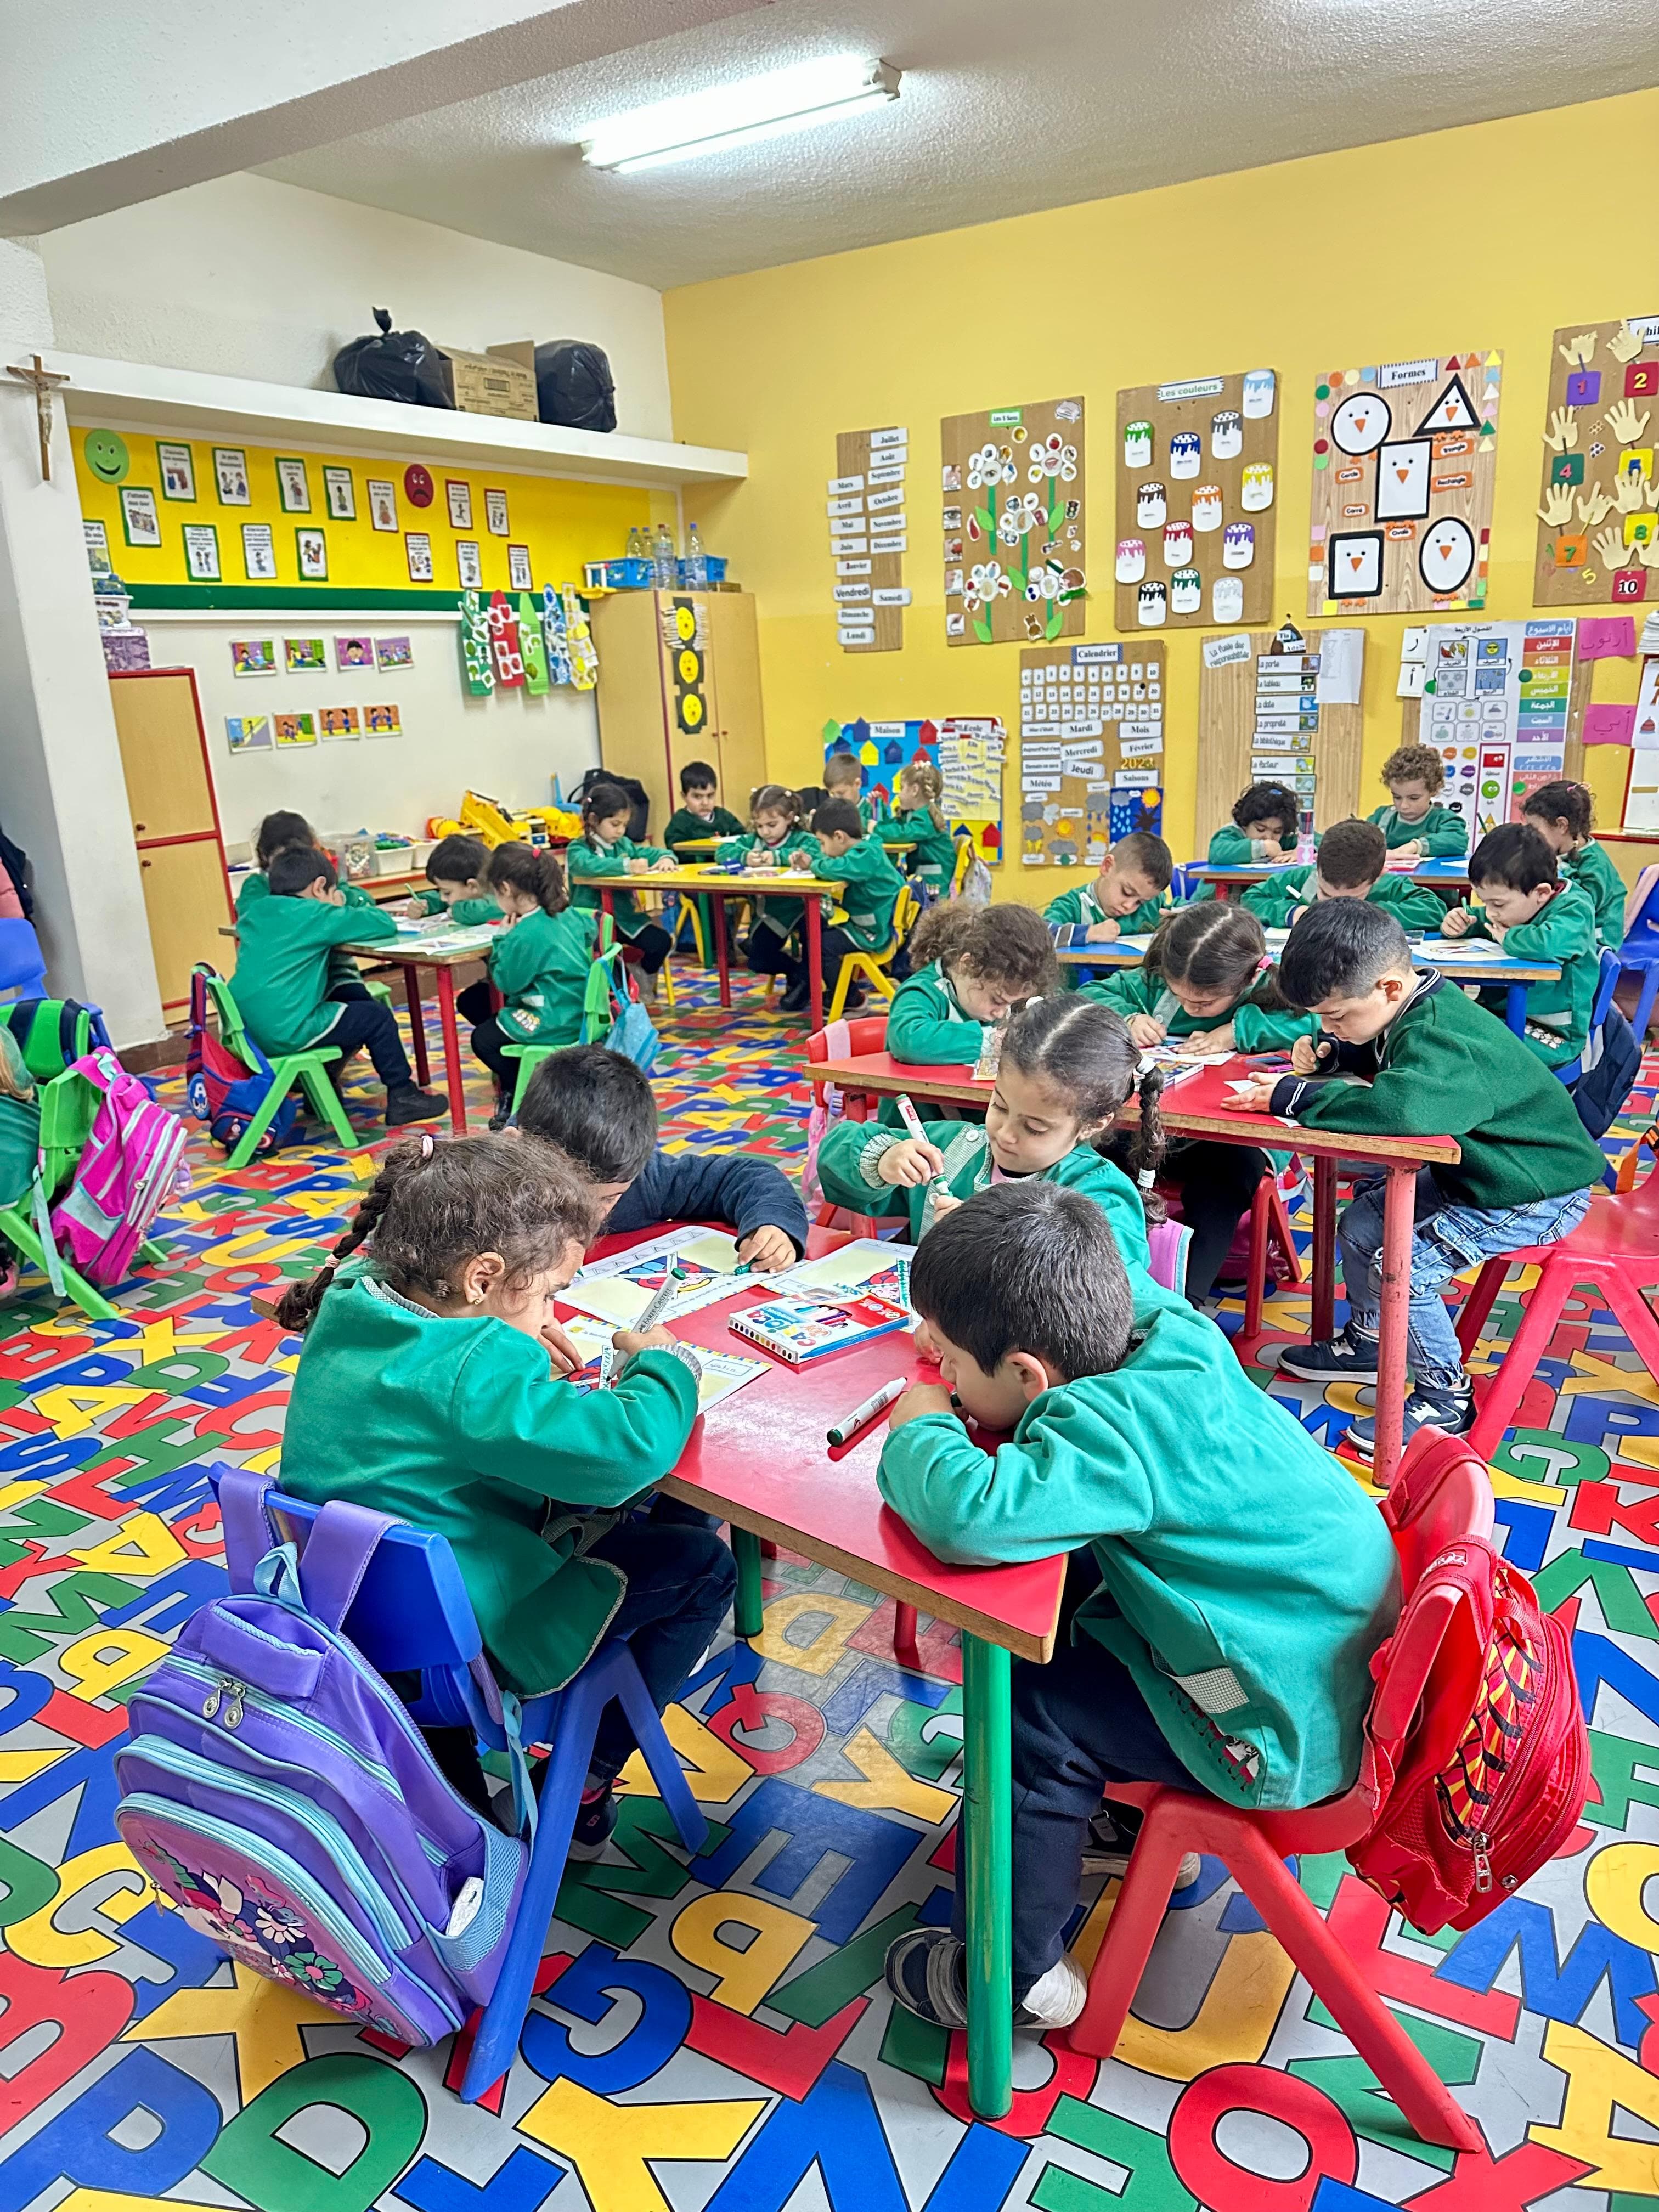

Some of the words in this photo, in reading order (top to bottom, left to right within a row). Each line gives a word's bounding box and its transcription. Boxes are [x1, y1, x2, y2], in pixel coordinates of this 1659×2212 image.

[1391, 369, 1426, 380] Formes
[1634, 373, 1647, 389] 2
[1160, 388, 1175, 397] Les
[1178, 384, 1218, 395] couleurs
[1578, 379, 1587, 395] 1
[1443, 443, 1466, 454] Triangle
[881, 453, 895, 461] Août
[871, 470, 900, 479] Septembre
[1560, 464, 1572, 479] 4
[874, 495, 898, 505] Octobre
[873, 519, 902, 527] Novembre
[1635, 524, 1647, 540] 8
[873, 540, 902, 549] Décembre
[1564, 546, 1577, 562] 7
[1582, 568, 1596, 584] 5
[1618, 579, 1638, 593] 10
[836, 587, 870, 597] Vendredi
[1078, 649, 1117, 658] Calendrier
[874, 726, 901, 734] Maison
[1069, 724, 1093, 733] Mardi
[1065, 747, 1098, 757] Mercredi
[1129, 743, 1154, 753] Février
[1071, 765, 1094, 775] Jeudi
